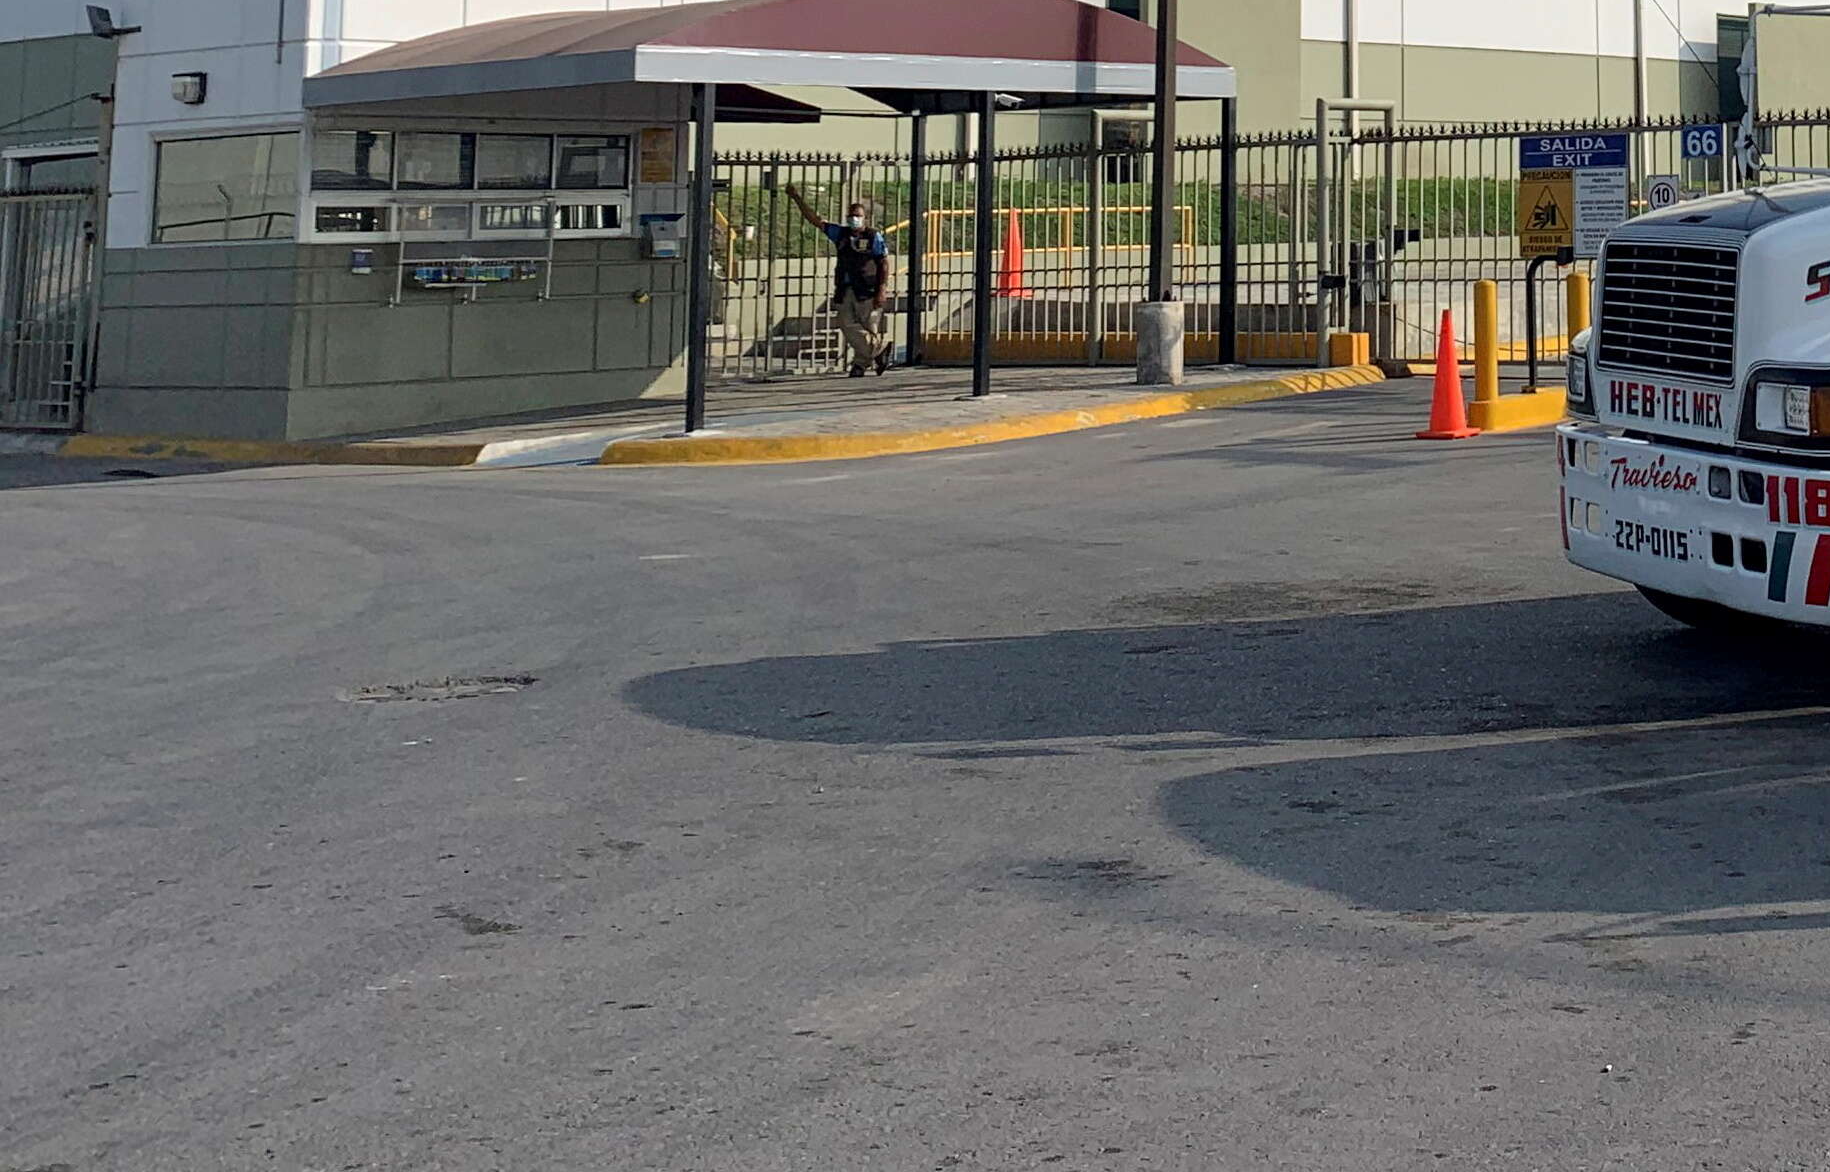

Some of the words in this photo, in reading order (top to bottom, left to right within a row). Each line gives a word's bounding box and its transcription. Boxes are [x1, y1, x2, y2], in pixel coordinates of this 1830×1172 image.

[1540, 137, 1607, 151] SALIDA
[1687, 130, 1718, 156] 66
[1552, 153, 1592, 167] EXIT
[1654, 188, 1669, 203] 10
[1610, 380, 1656, 418] HEB
[1610, 454, 1697, 491] Travieso
[1615, 520, 1688, 561] 22P-0115
